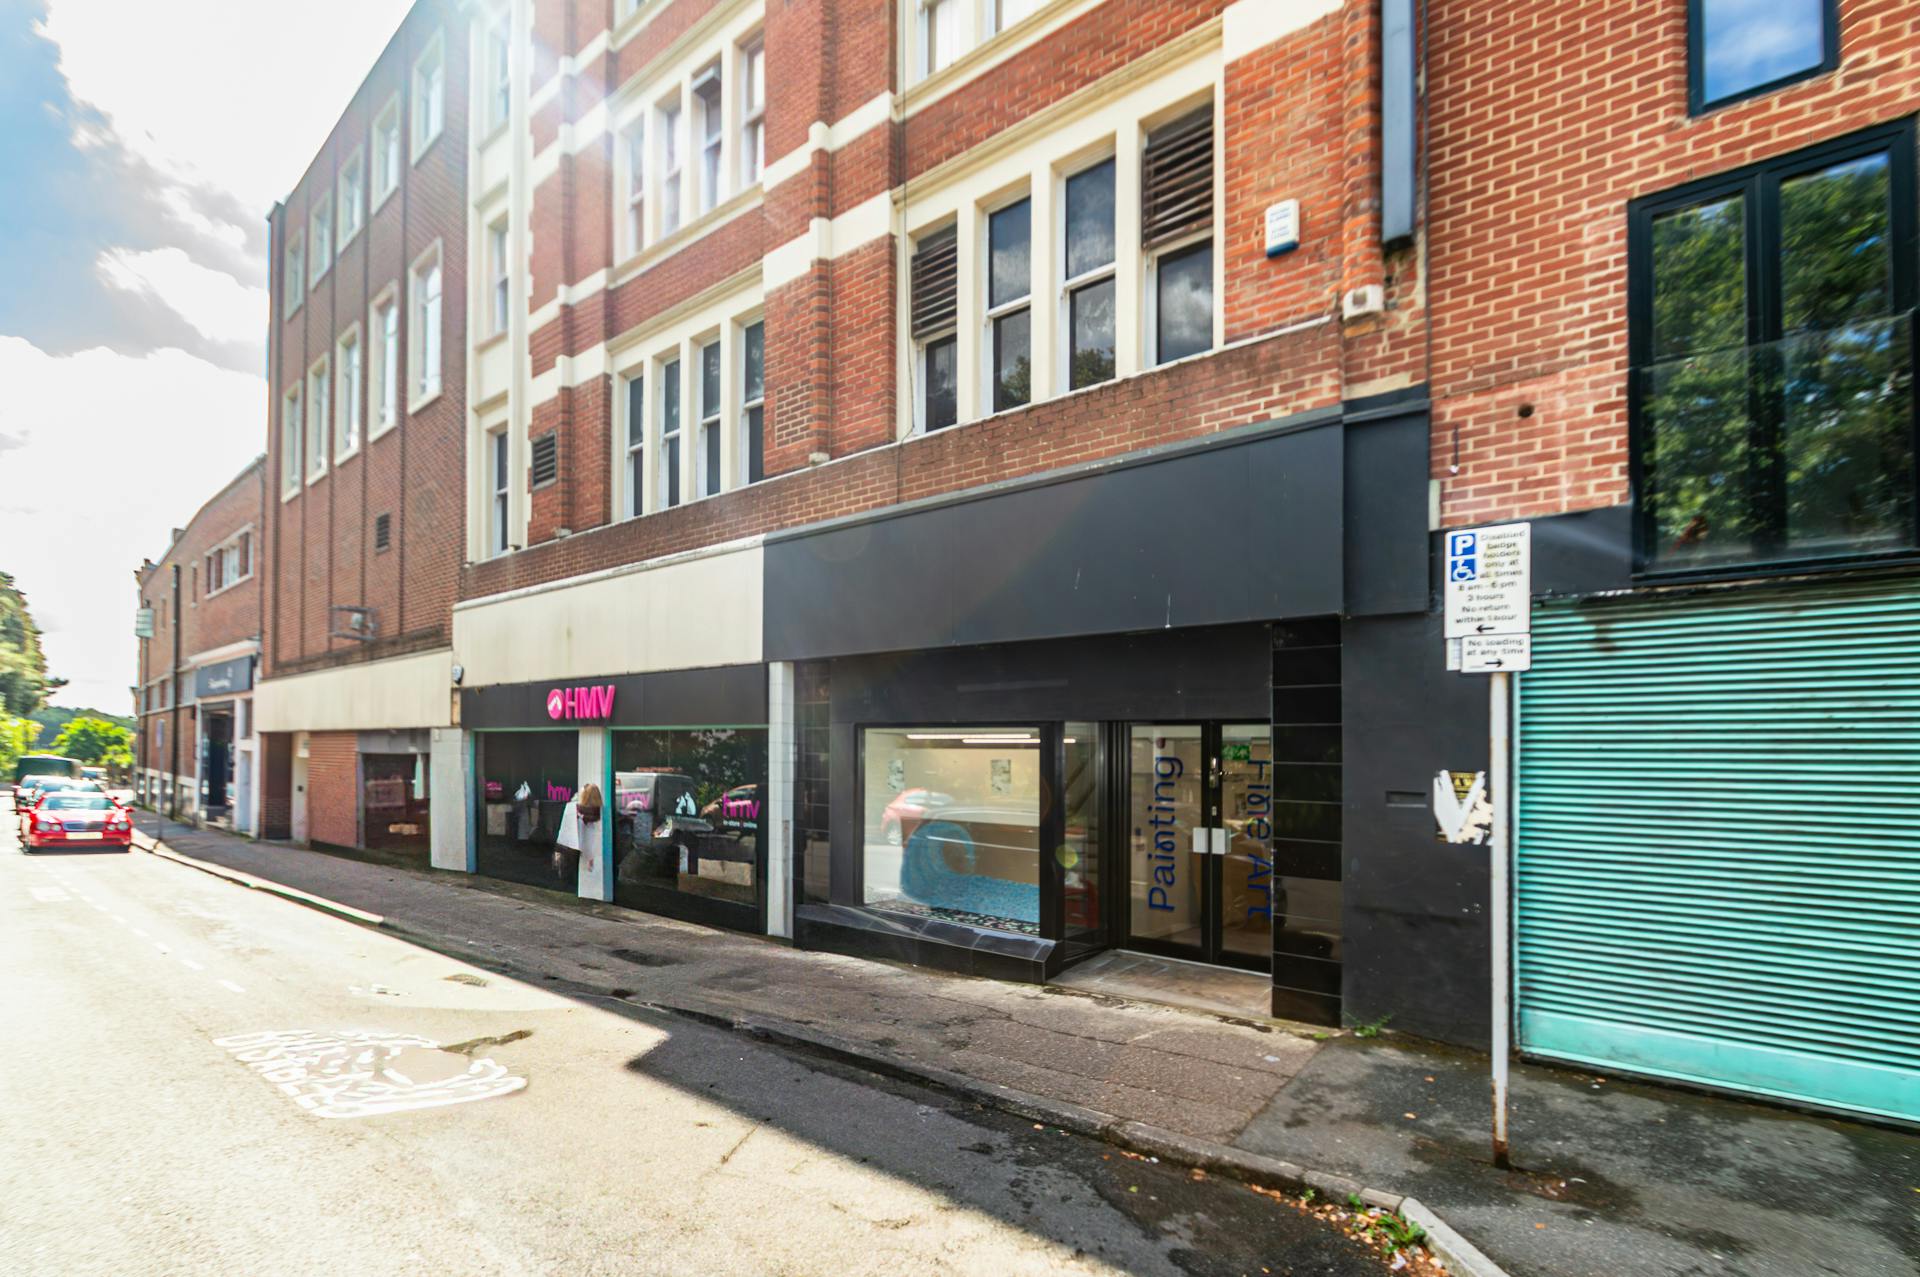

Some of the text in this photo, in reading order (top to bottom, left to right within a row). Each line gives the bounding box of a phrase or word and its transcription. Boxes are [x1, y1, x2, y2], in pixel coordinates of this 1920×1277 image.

[1455, 535, 1474, 555] P
[1462, 605, 1477, 613] No
[1468, 639, 1482, 647] No
[565, 685, 616, 719] HMV
[546, 777, 572, 802] hmv
[722, 791, 761, 819] hmv
[1147, 756, 1183, 912] Painting
